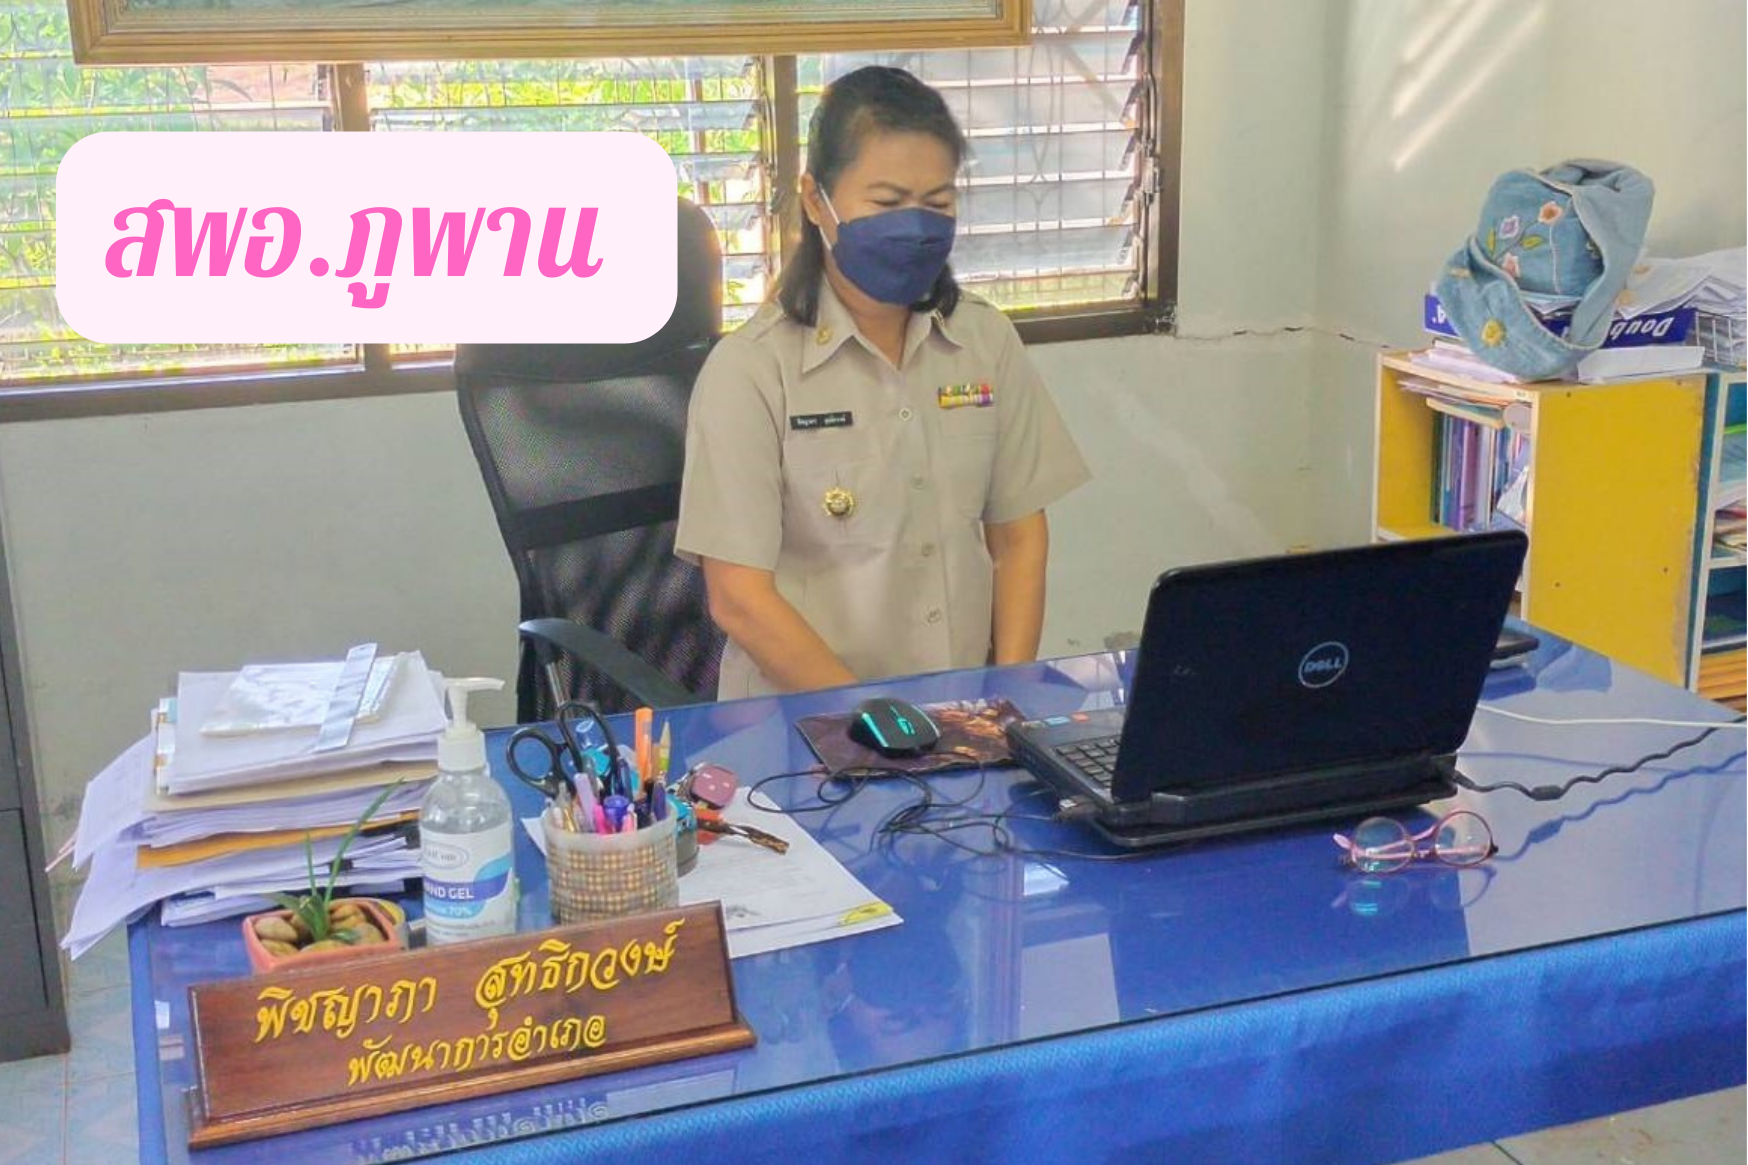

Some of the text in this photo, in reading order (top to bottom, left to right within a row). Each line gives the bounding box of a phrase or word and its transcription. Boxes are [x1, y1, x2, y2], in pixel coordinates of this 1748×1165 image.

[1609, 317, 1675, 340] Doub
[1304, 656, 1343, 673] DELL
[448, 887, 476, 900] GEL
[255, 918, 685, 1043] พิชญาภา สุทธิกวงษ์
[348, 1015, 607, 1086] พัฒนาการอำเภอ
